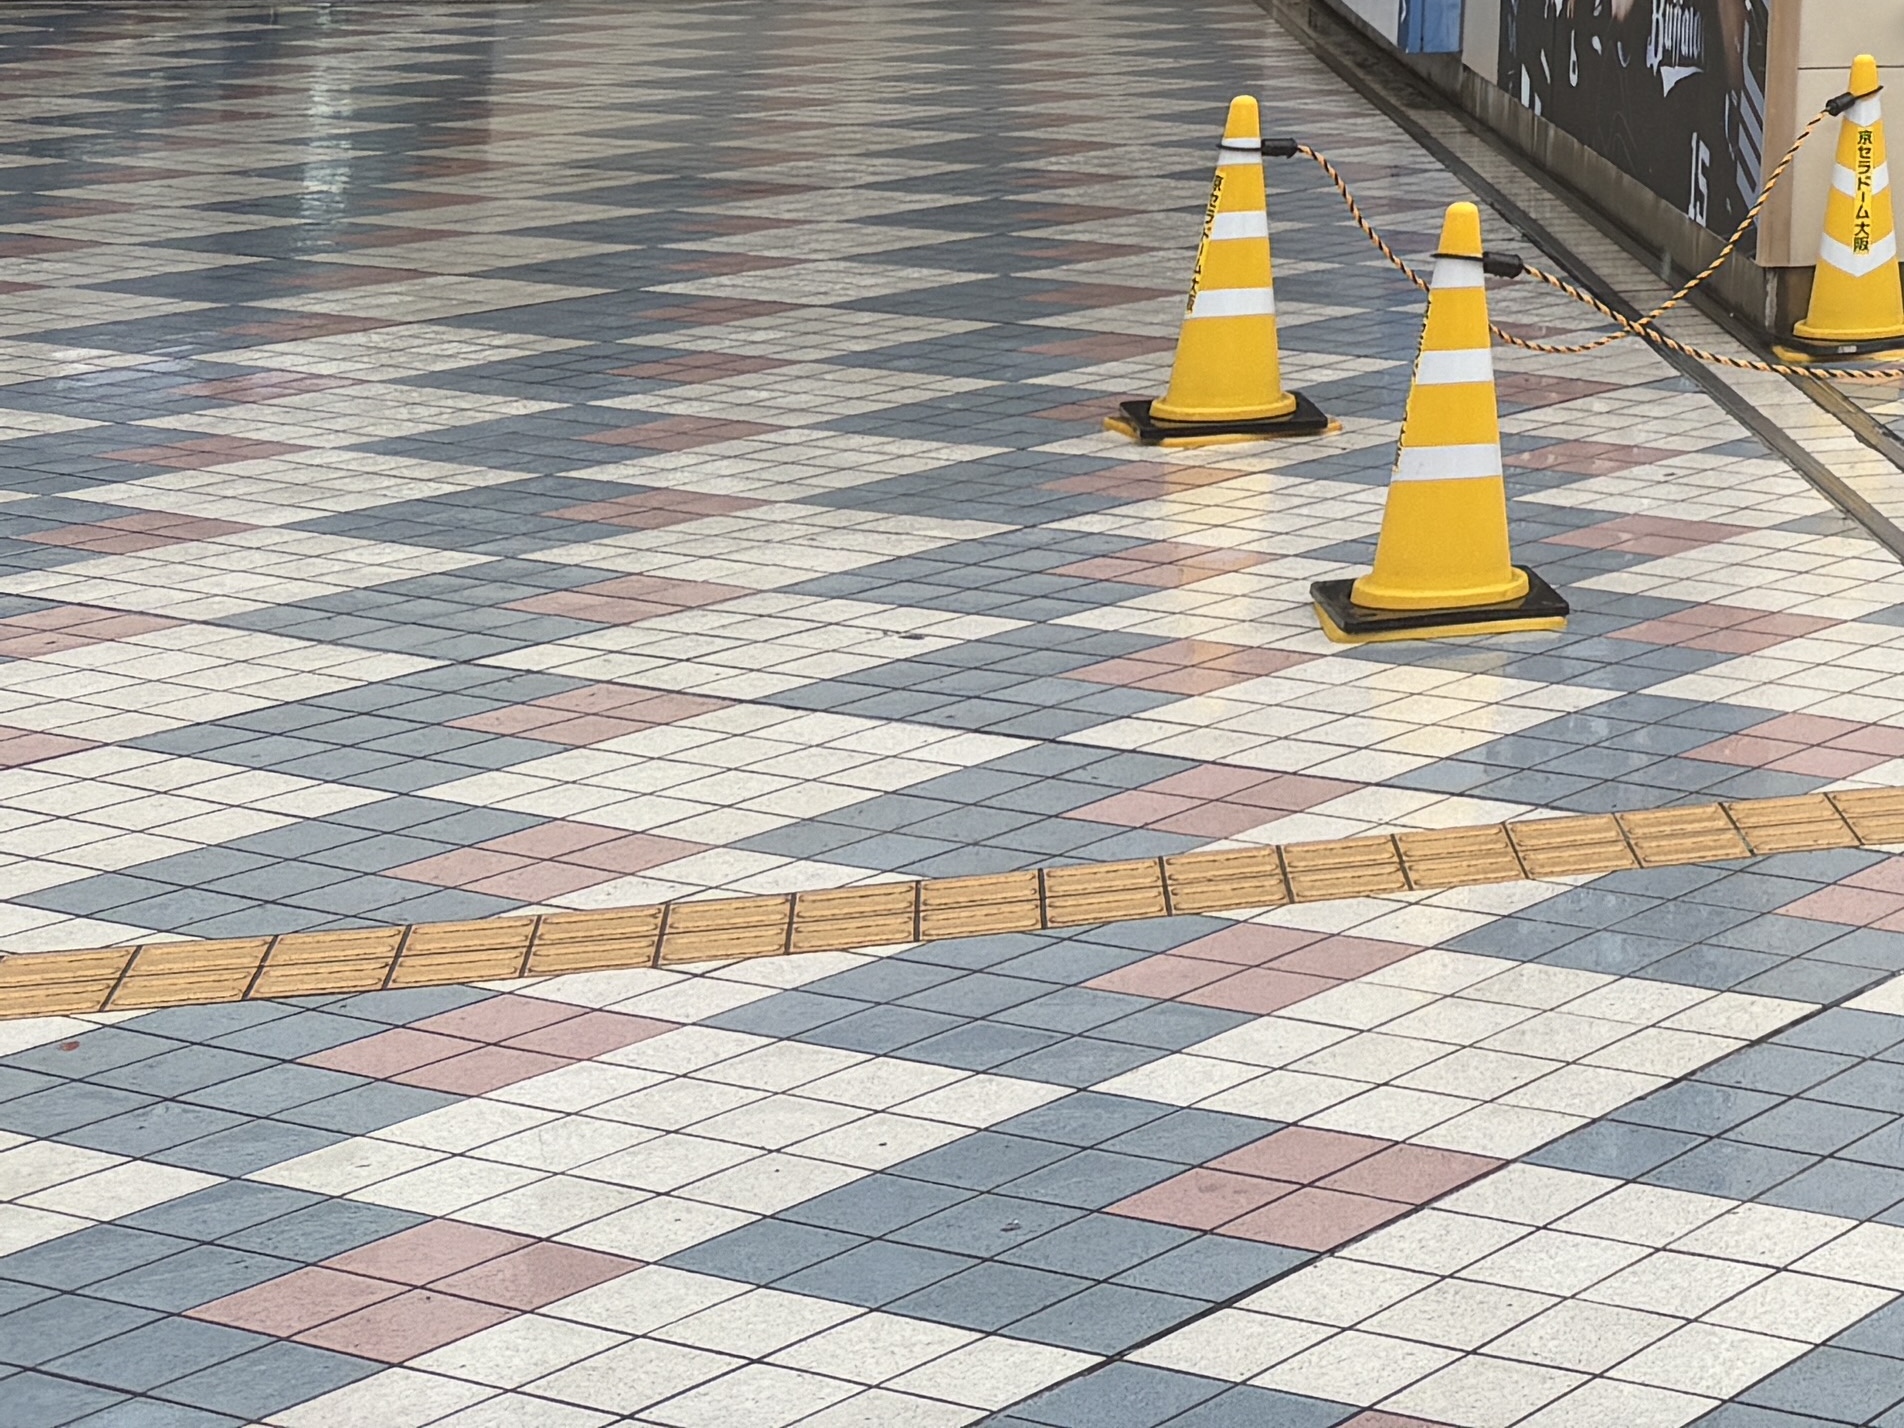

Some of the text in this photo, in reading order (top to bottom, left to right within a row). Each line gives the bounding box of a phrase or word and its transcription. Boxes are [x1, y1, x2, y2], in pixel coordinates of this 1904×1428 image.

[1853, 130, 1873, 253] 京セラドーム大阪
